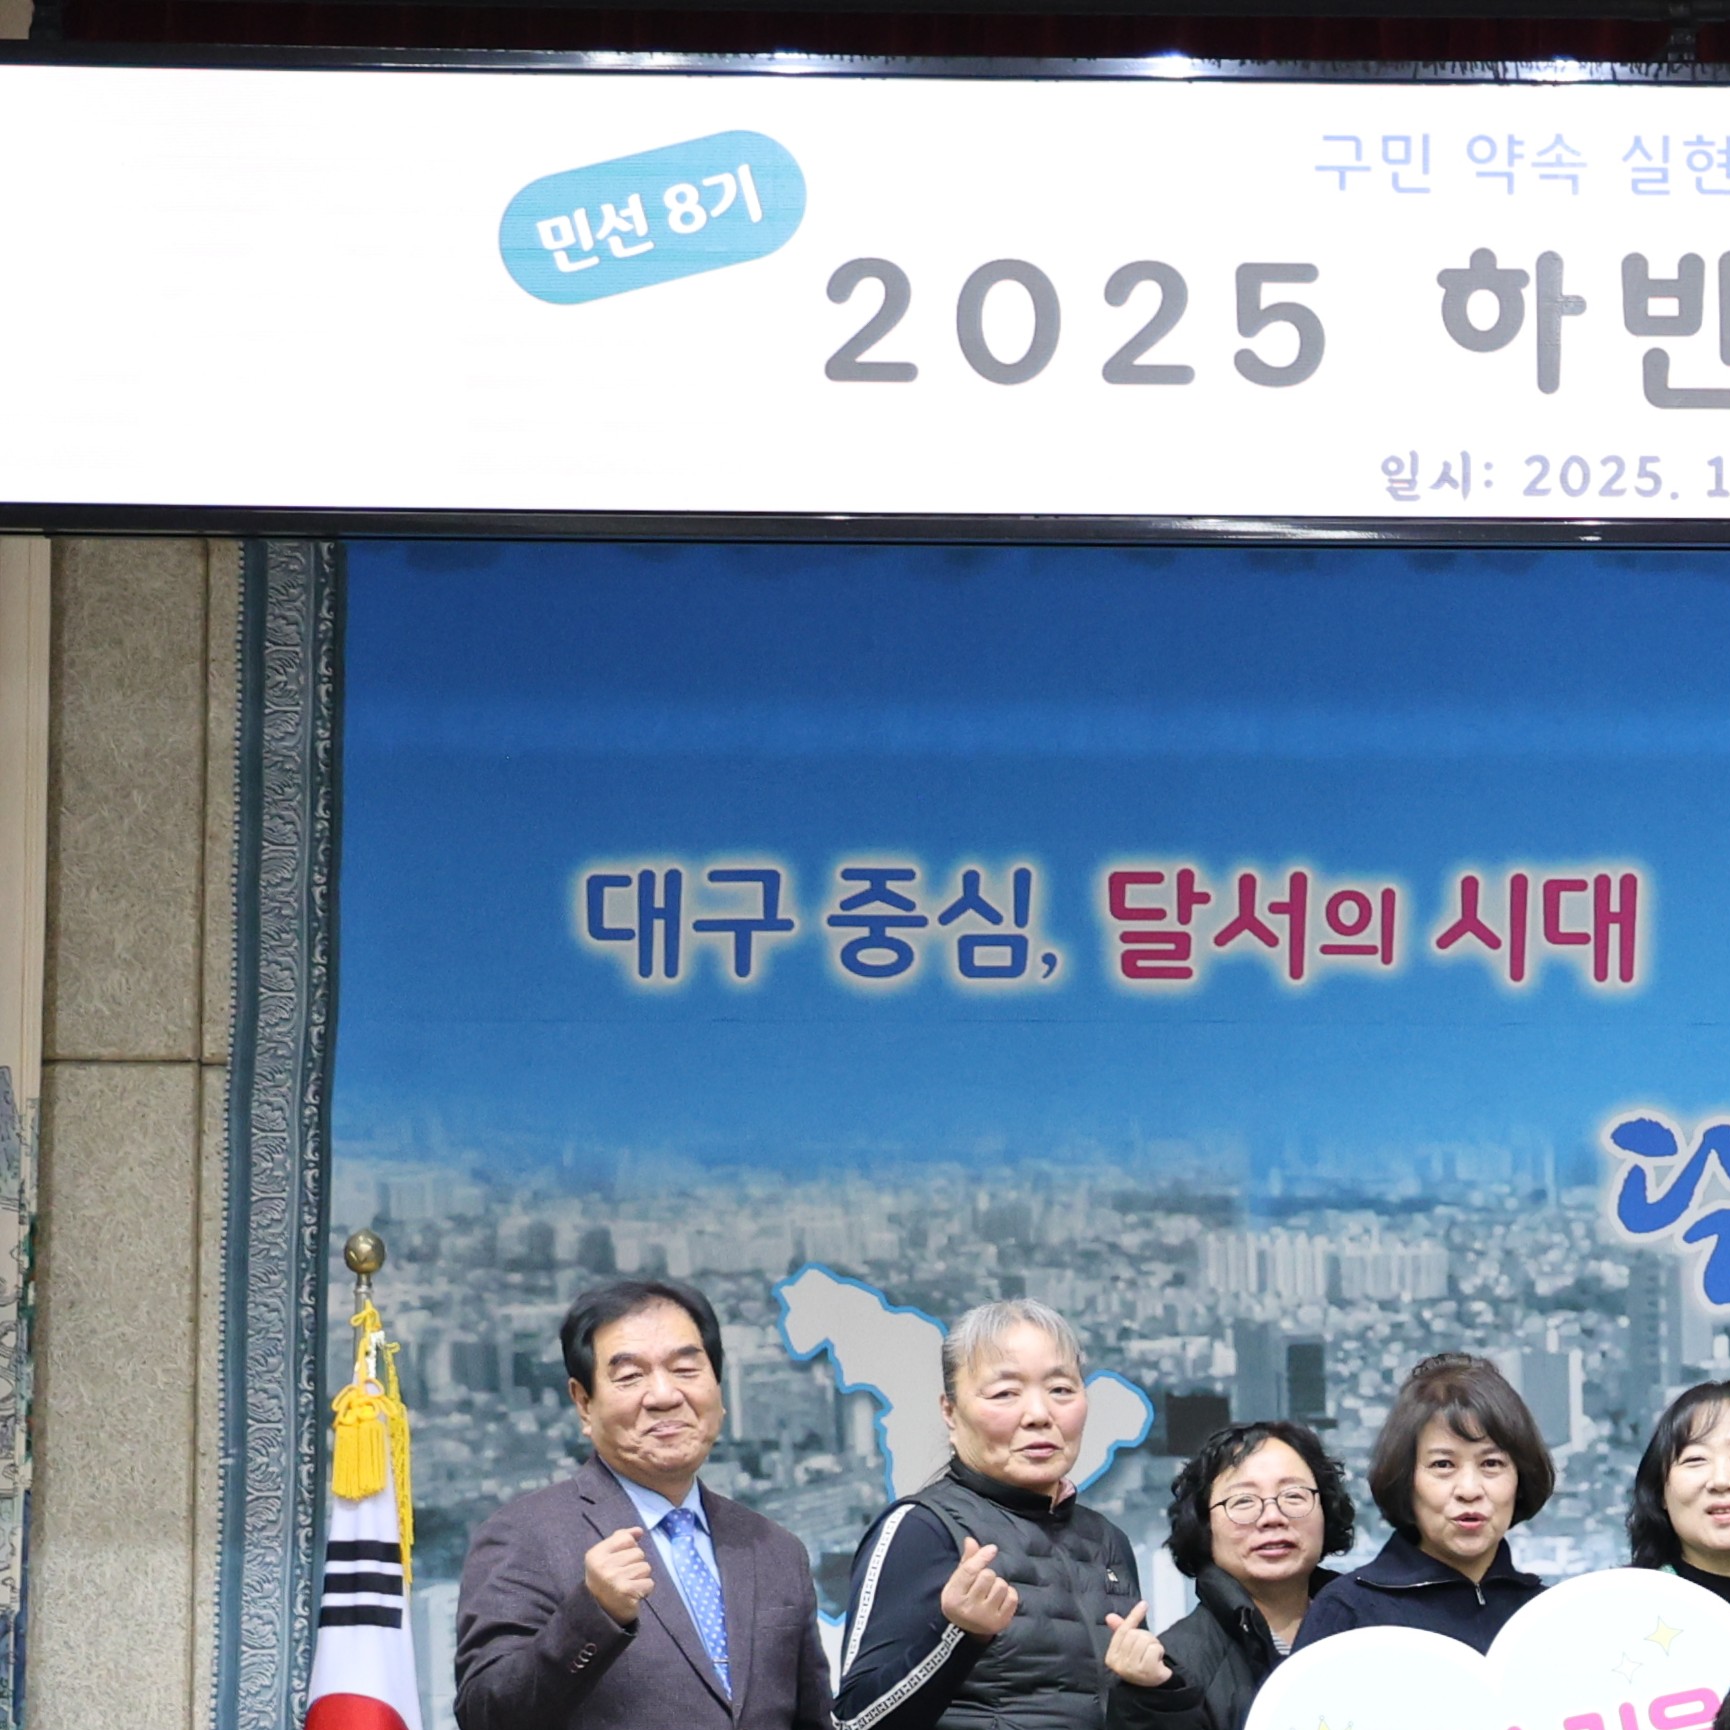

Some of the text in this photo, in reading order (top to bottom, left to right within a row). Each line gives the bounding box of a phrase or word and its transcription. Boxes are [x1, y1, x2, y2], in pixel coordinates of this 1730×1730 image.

[536, 163, 763, 273] 민선 8기
[1315, 134, 1430, 193] 구민
[1467, 134, 1585, 194] 약속
[824, 257, 1326, 388] 2025
[1381, 451, 1492, 501] 일시:
[1523, 455, 1678, 499] 2025.
[586, 867, 1640, 983] 대구 중심, 달서의 시대
